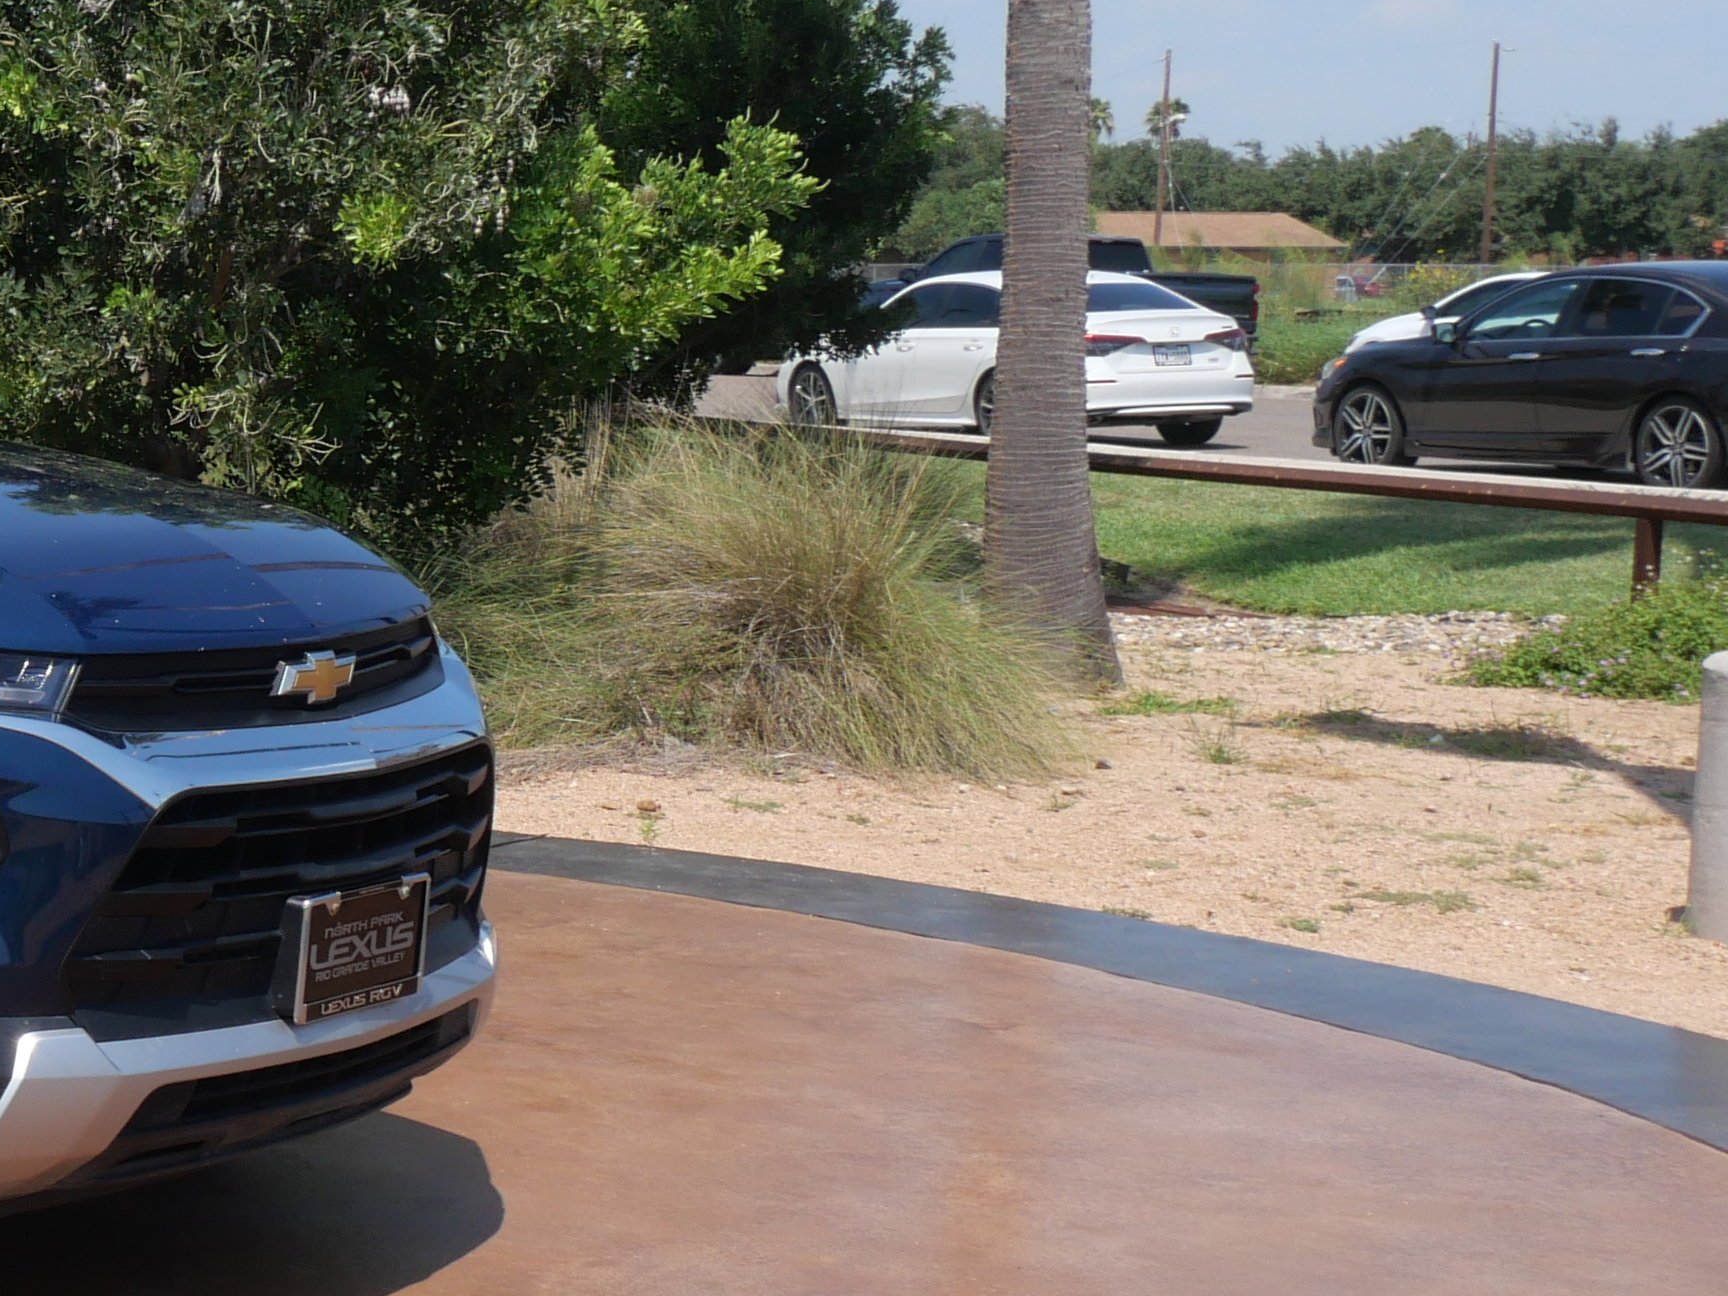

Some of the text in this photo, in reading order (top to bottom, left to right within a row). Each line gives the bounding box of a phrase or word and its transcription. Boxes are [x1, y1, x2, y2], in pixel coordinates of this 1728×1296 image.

[324, 911, 404, 940] NORTH PARK
[310, 921, 414, 970] LEXUS
[315, 952, 406, 982] RIO GRANDE VALLEY
[321, 983, 403, 1015] LEXUS RGV
